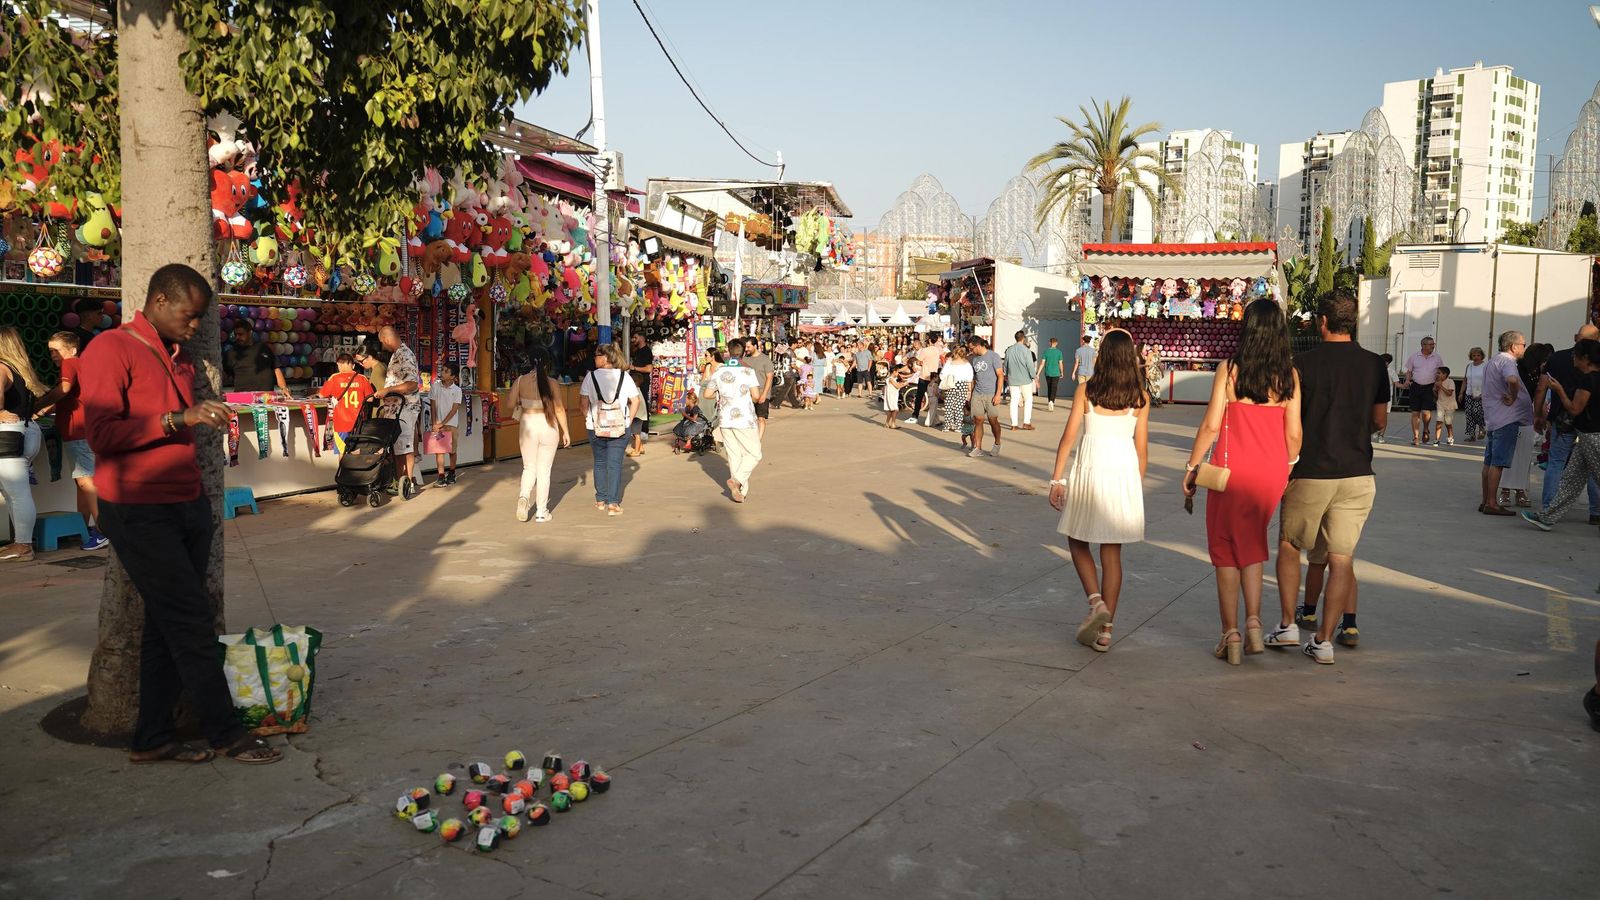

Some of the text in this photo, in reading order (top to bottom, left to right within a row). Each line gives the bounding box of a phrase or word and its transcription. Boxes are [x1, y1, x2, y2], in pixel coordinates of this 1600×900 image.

[449, 308, 457, 362] BARCONA
[343, 391, 360, 409] 14
[662, 383, 673, 405] PEDRI
